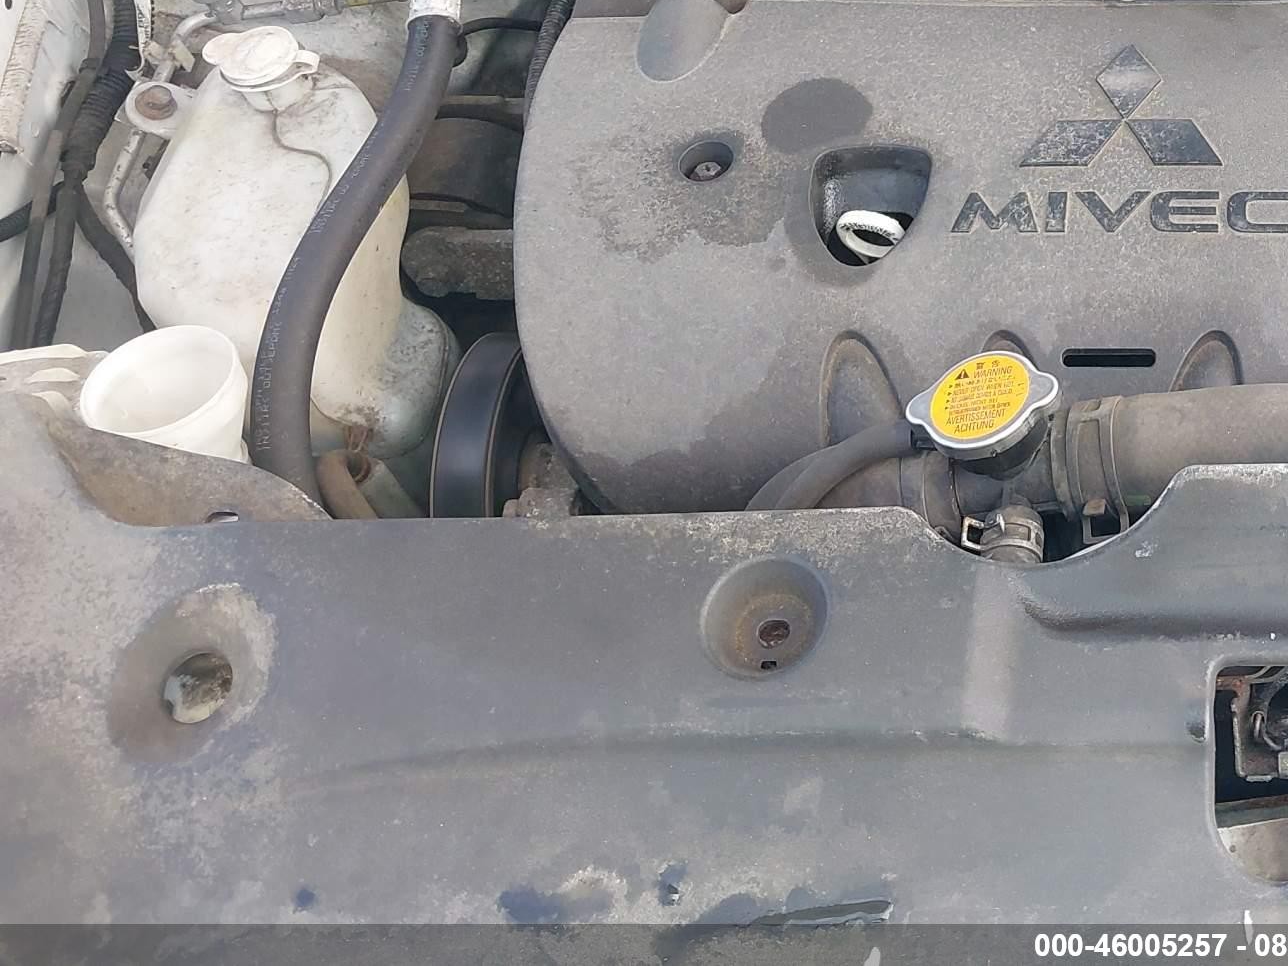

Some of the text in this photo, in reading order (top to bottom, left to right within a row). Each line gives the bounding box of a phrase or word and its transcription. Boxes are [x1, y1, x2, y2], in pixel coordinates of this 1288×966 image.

[973, 365, 1013, 379] WARNING
[946, 408, 1007, 426] AVERTISSEMENT
[954, 419, 995, 434] ACHTUNG
